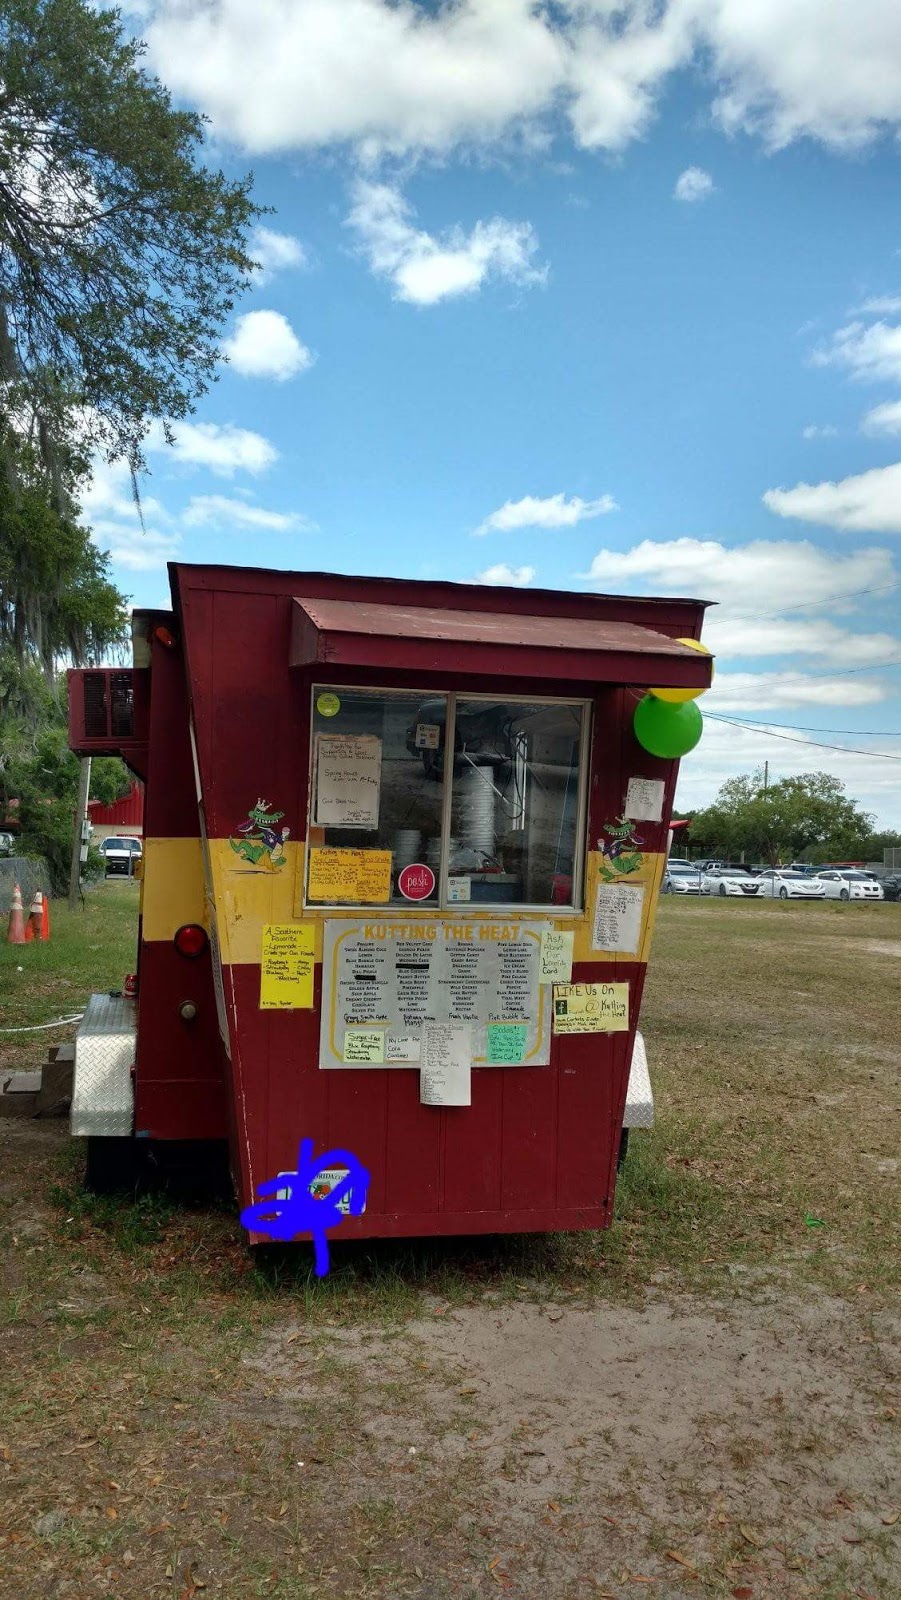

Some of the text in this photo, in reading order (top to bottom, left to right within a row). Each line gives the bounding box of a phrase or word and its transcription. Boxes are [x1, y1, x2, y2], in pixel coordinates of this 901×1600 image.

[324, 769, 342, 778] Spring
[265, 926, 303, 936] A Southern
[364, 925, 519, 941] KUTTING THE HEAT
[547, 933, 563, 943] Ask
[543, 966, 558, 975] Card
[556, 985, 614, 997] LIKE Us On
[602, 1000, 626, 1011] Kutting
